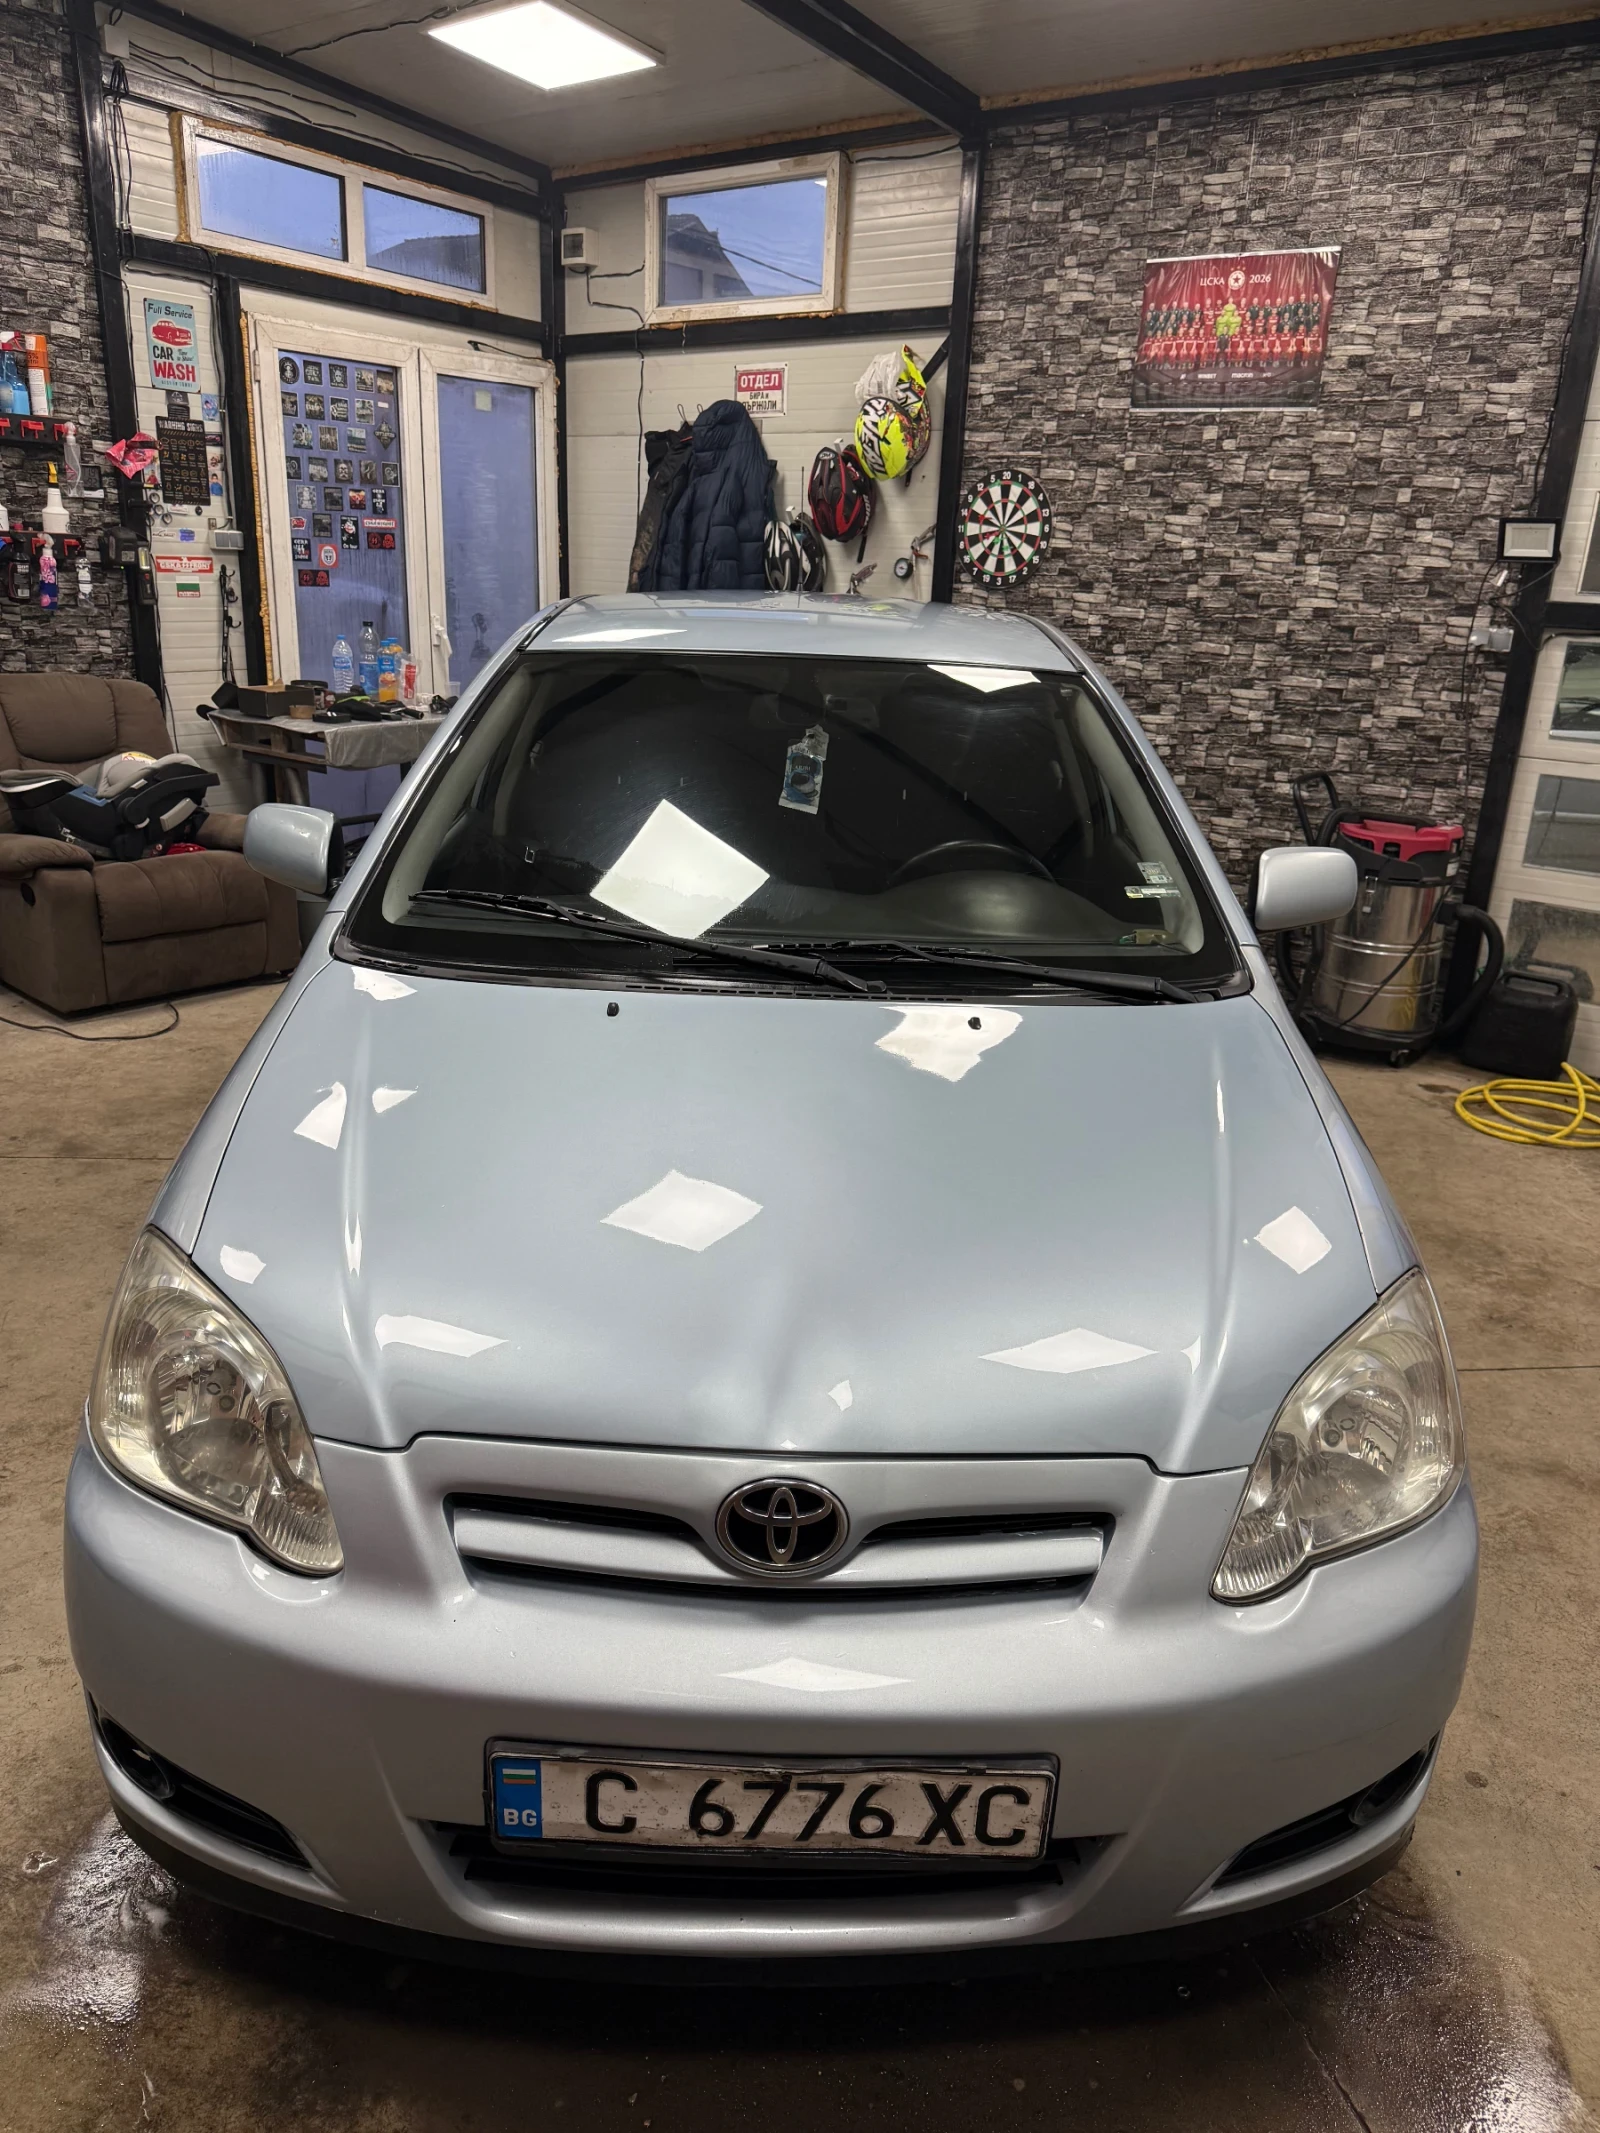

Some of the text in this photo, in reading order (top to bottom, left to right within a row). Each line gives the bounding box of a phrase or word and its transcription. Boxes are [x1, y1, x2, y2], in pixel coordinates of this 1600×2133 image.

[1200, 274, 1271, 286] ЦСКА 2026
[148, 303, 192, 318] Full Service
[152, 345, 174, 361] CAR
[153, 360, 196, 382] WASH
[740, 373, 779, 389] ОТДЕЛ
[749, 392, 765, 400] БИРА
[158, 420, 203, 433] WARNING SIGNS
[990, 475, 995, 483] 5
[1002, 471, 1011, 480] 20
[977, 483, 984, 491] 12
[1028, 481, 1035, 489] 18
[1038, 493, 1043, 501] 4
[1042, 509, 1049, 517] 13
[959, 541, 964, 549] 8
[1040, 541, 1047, 549] 10
[963, 555, 970, 563] 16
[1022, 567, 1028, 575] 2
[982, 575, 990, 583] 19
[585, 1770, 1030, 1847] C 6776 XC
[504, 1808, 538, 1826] BG
